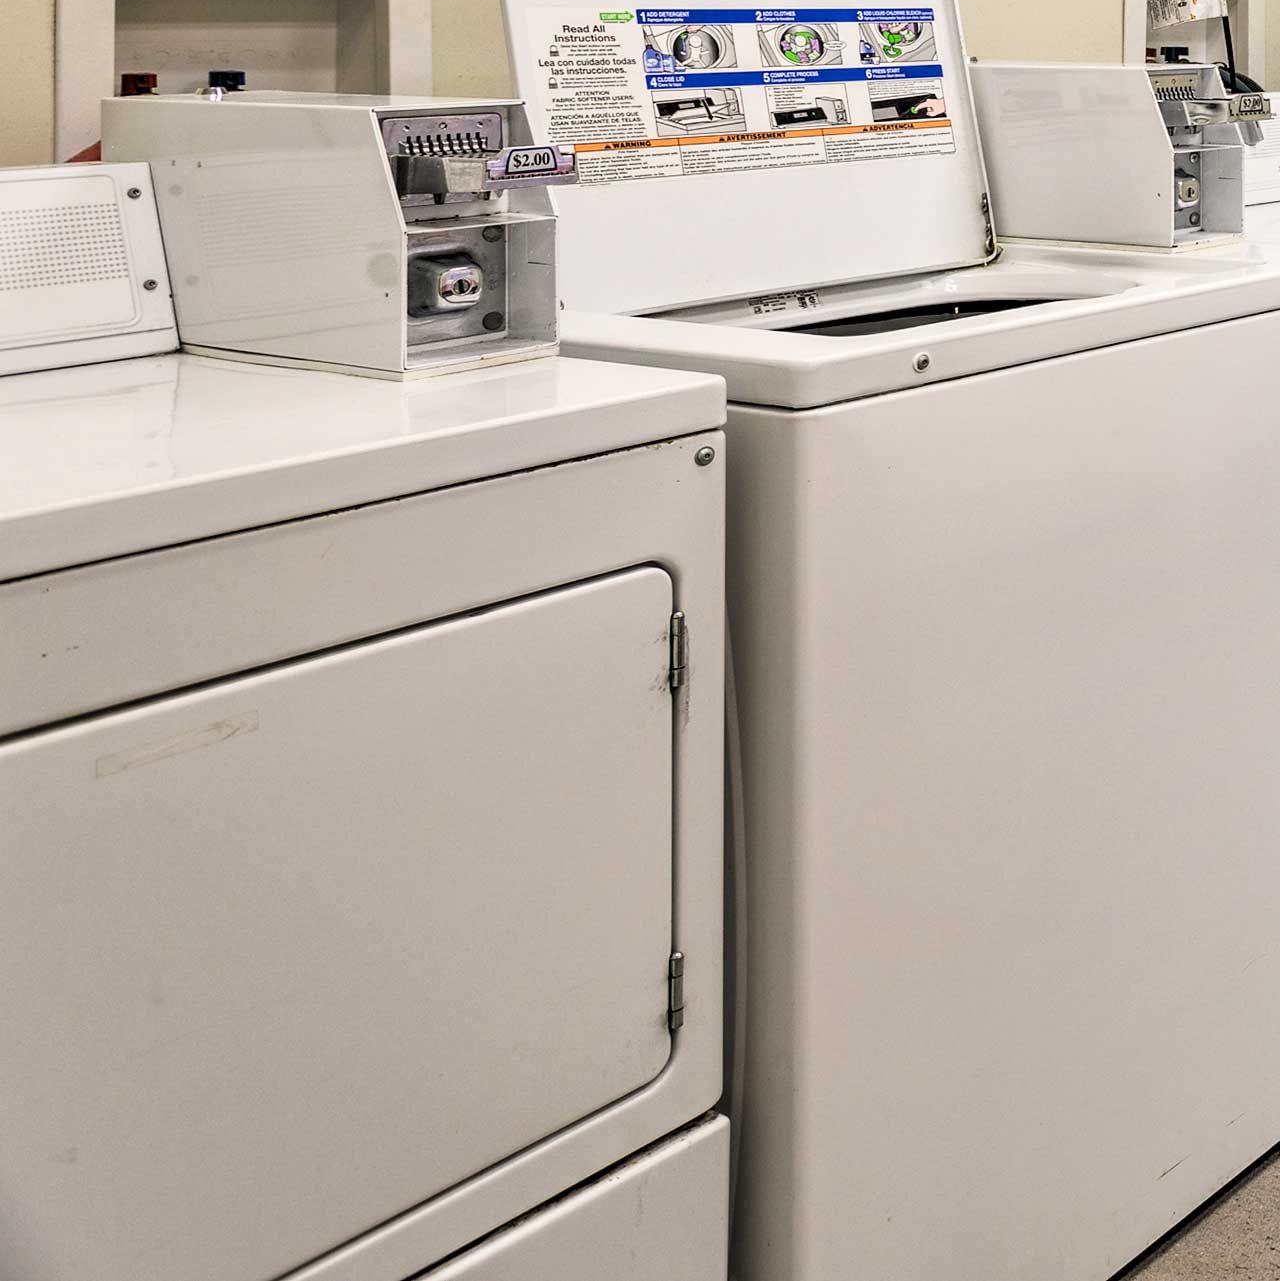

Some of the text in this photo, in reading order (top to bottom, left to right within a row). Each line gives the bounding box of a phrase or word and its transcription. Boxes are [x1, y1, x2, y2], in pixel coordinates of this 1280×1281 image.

[640, 11, 646, 22] 1
[755, 10, 763, 21] 2
[857, 11, 864, 21] 3
[562, 25, 606, 33] Read All
[554, 34, 616, 42] Instructions
[538, 59, 555, 67] Lea
[576, 58, 610, 66] cuidado
[763, 72, 770, 83] 5
[866, 69, 872, 79] 6
[650, 77, 657, 87] 4
[869, 123, 915, 132] ADVERTENCIA
[727, 132, 786, 141] AVERTISSEMENT
[612, 140, 652, 149] WARNING
[513, 152, 550, 168] $2.00
